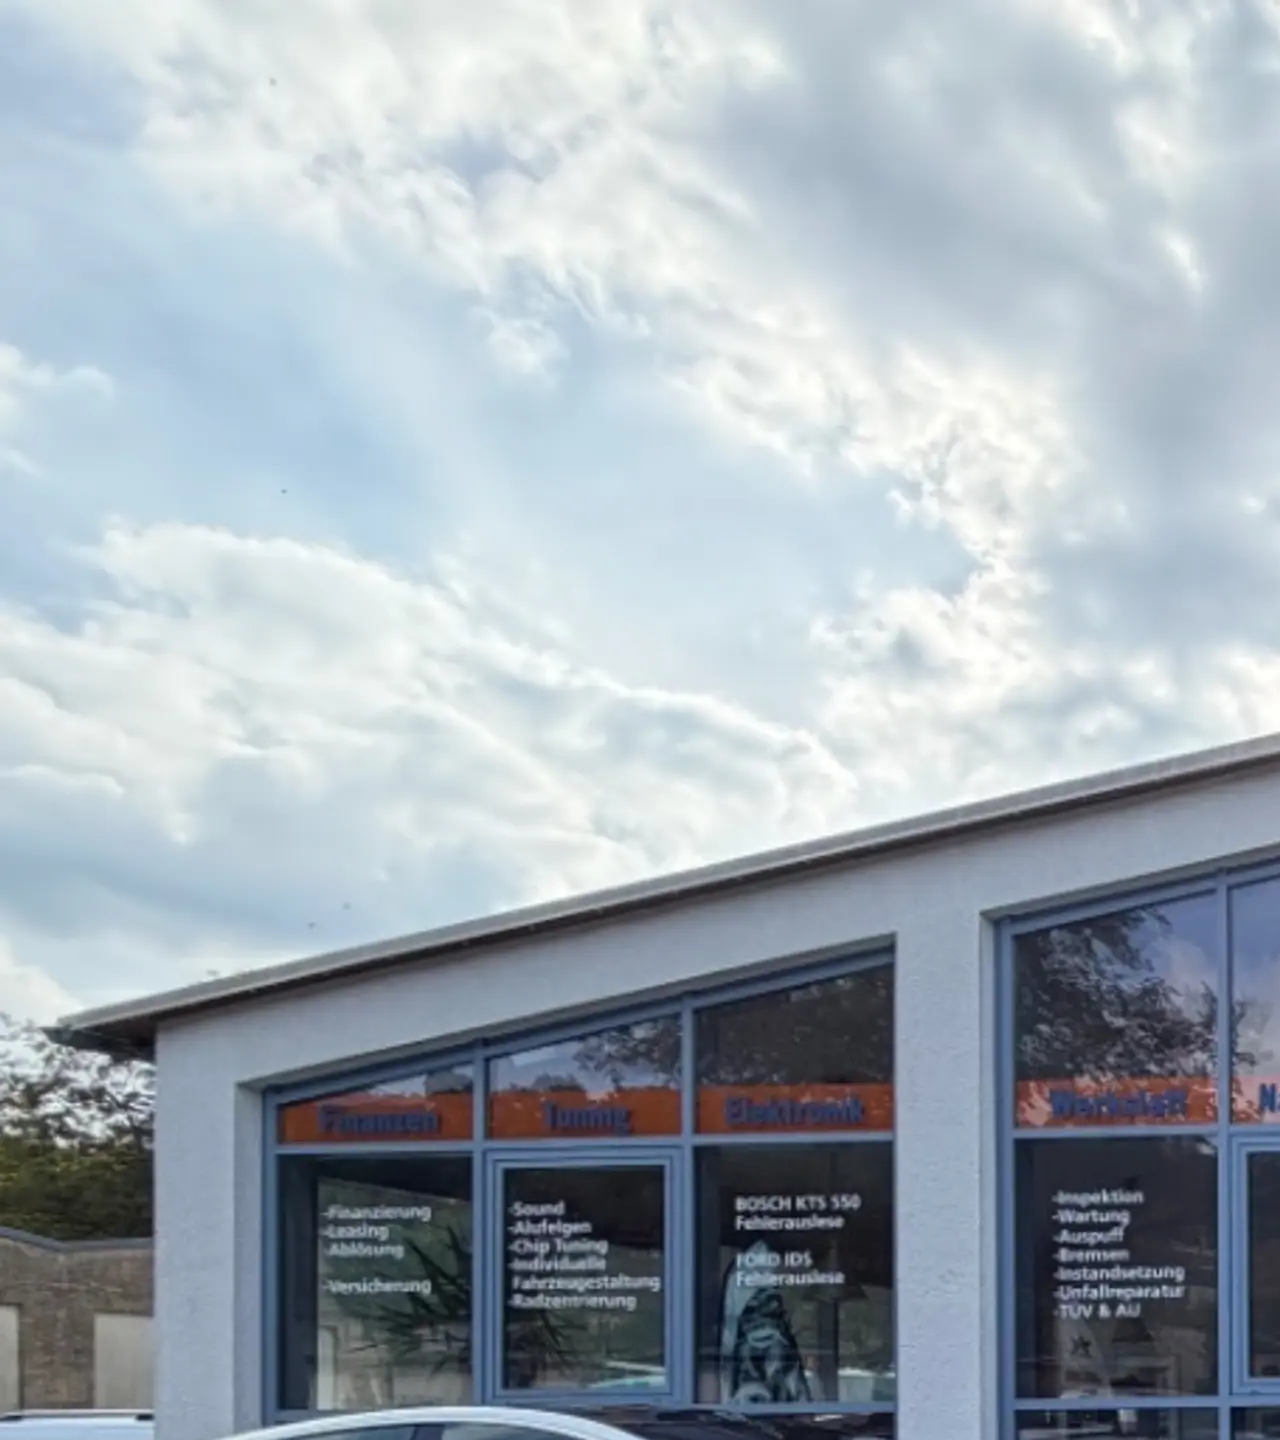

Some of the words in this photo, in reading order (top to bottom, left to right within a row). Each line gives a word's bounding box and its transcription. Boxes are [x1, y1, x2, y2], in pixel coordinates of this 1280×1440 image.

[543, 1100, 632, 1136] Tuning
[735, 1195, 791, 1212] BOSCH
[795, 1194, 826, 1211] KTS
[735, 1213, 844, 1231] Fehlerauslese
[555, 1238, 609, 1255] Tuning
